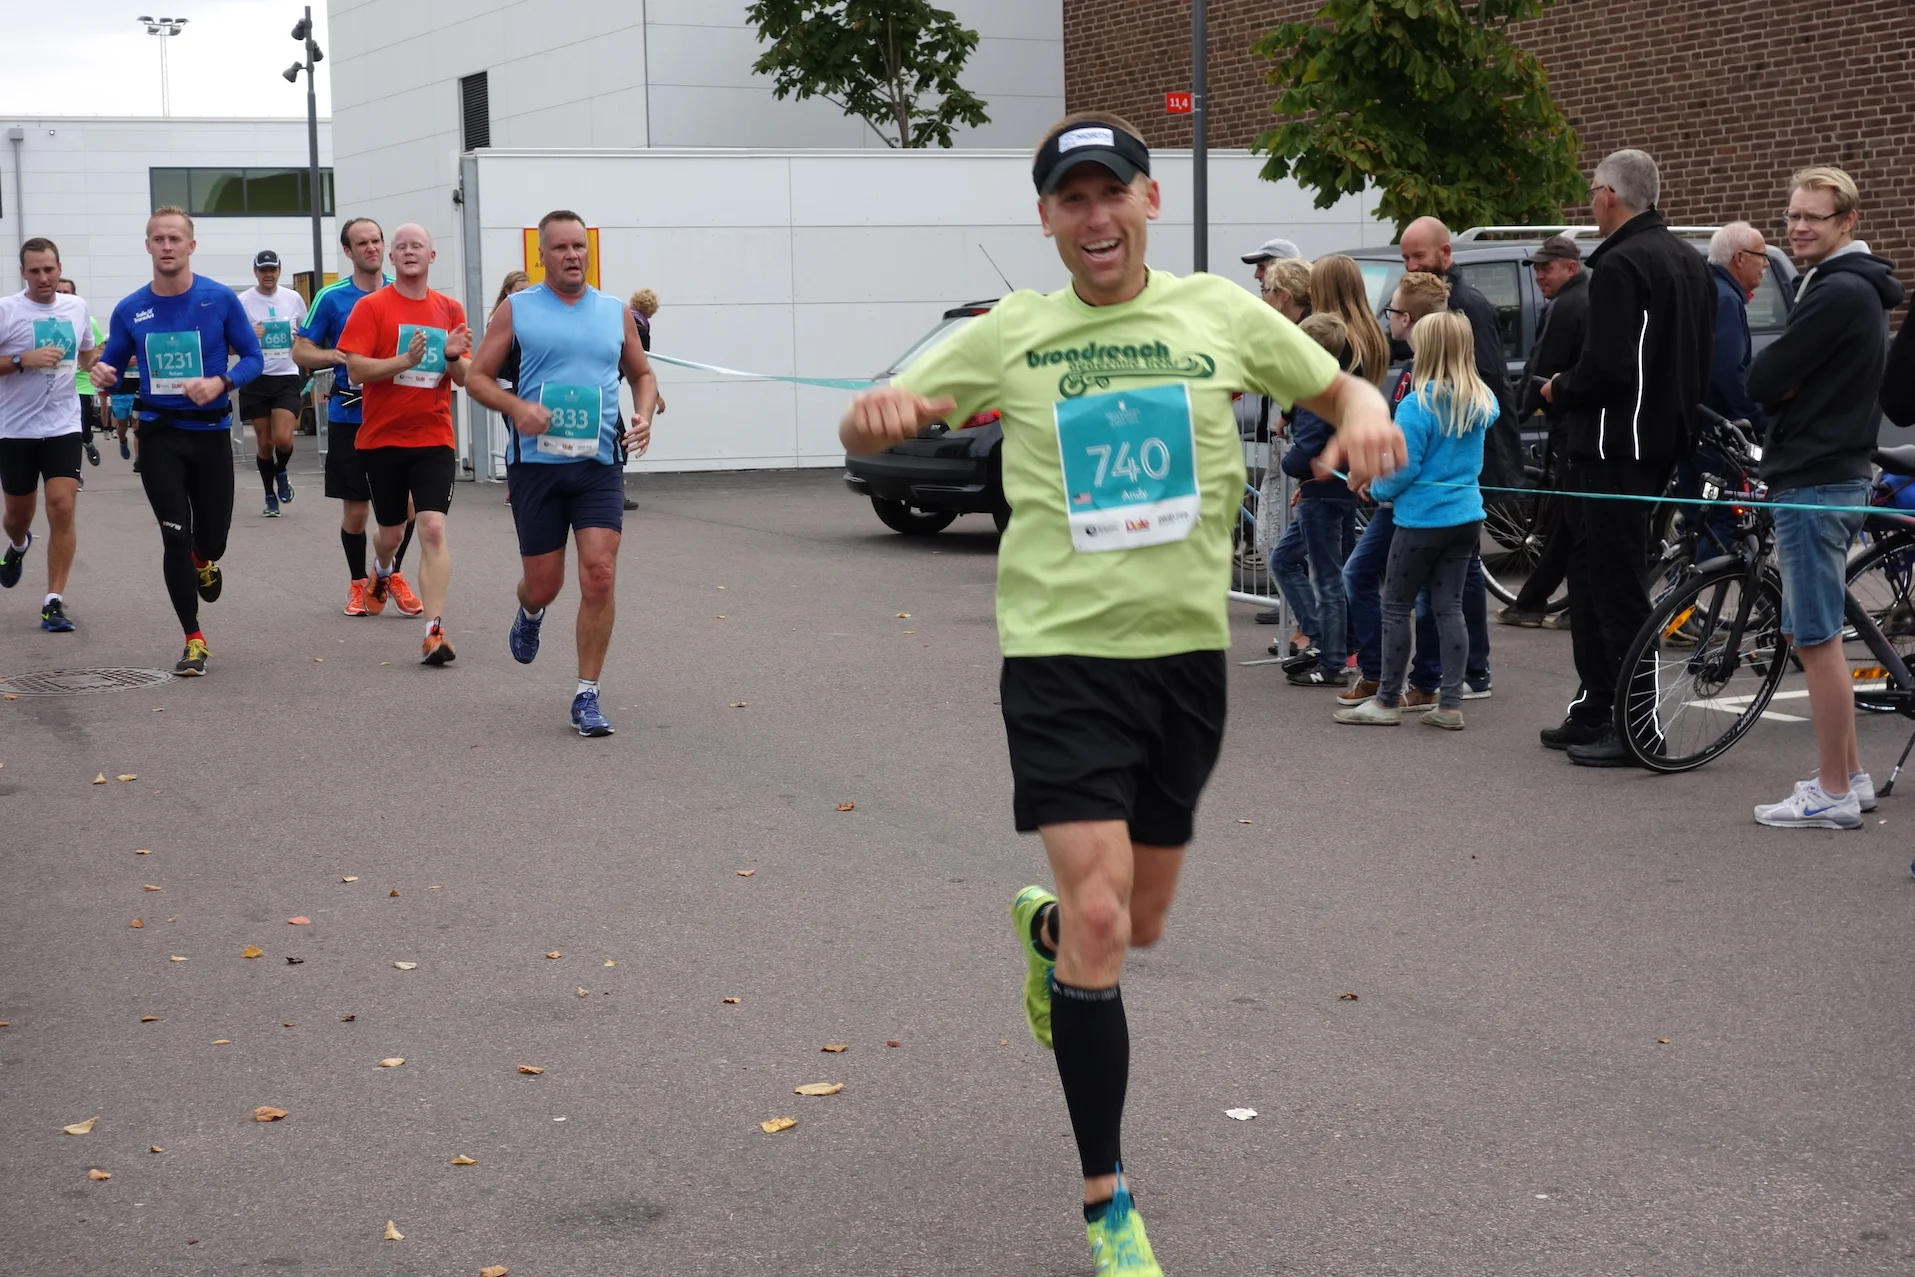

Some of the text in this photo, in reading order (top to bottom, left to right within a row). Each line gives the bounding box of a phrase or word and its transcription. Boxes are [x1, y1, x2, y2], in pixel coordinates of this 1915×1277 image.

[265, 333, 287, 344] 668
[155, 352, 193, 370] 1231
[551, 407, 588, 429] 833
[1086, 437, 1170, 488] 740
